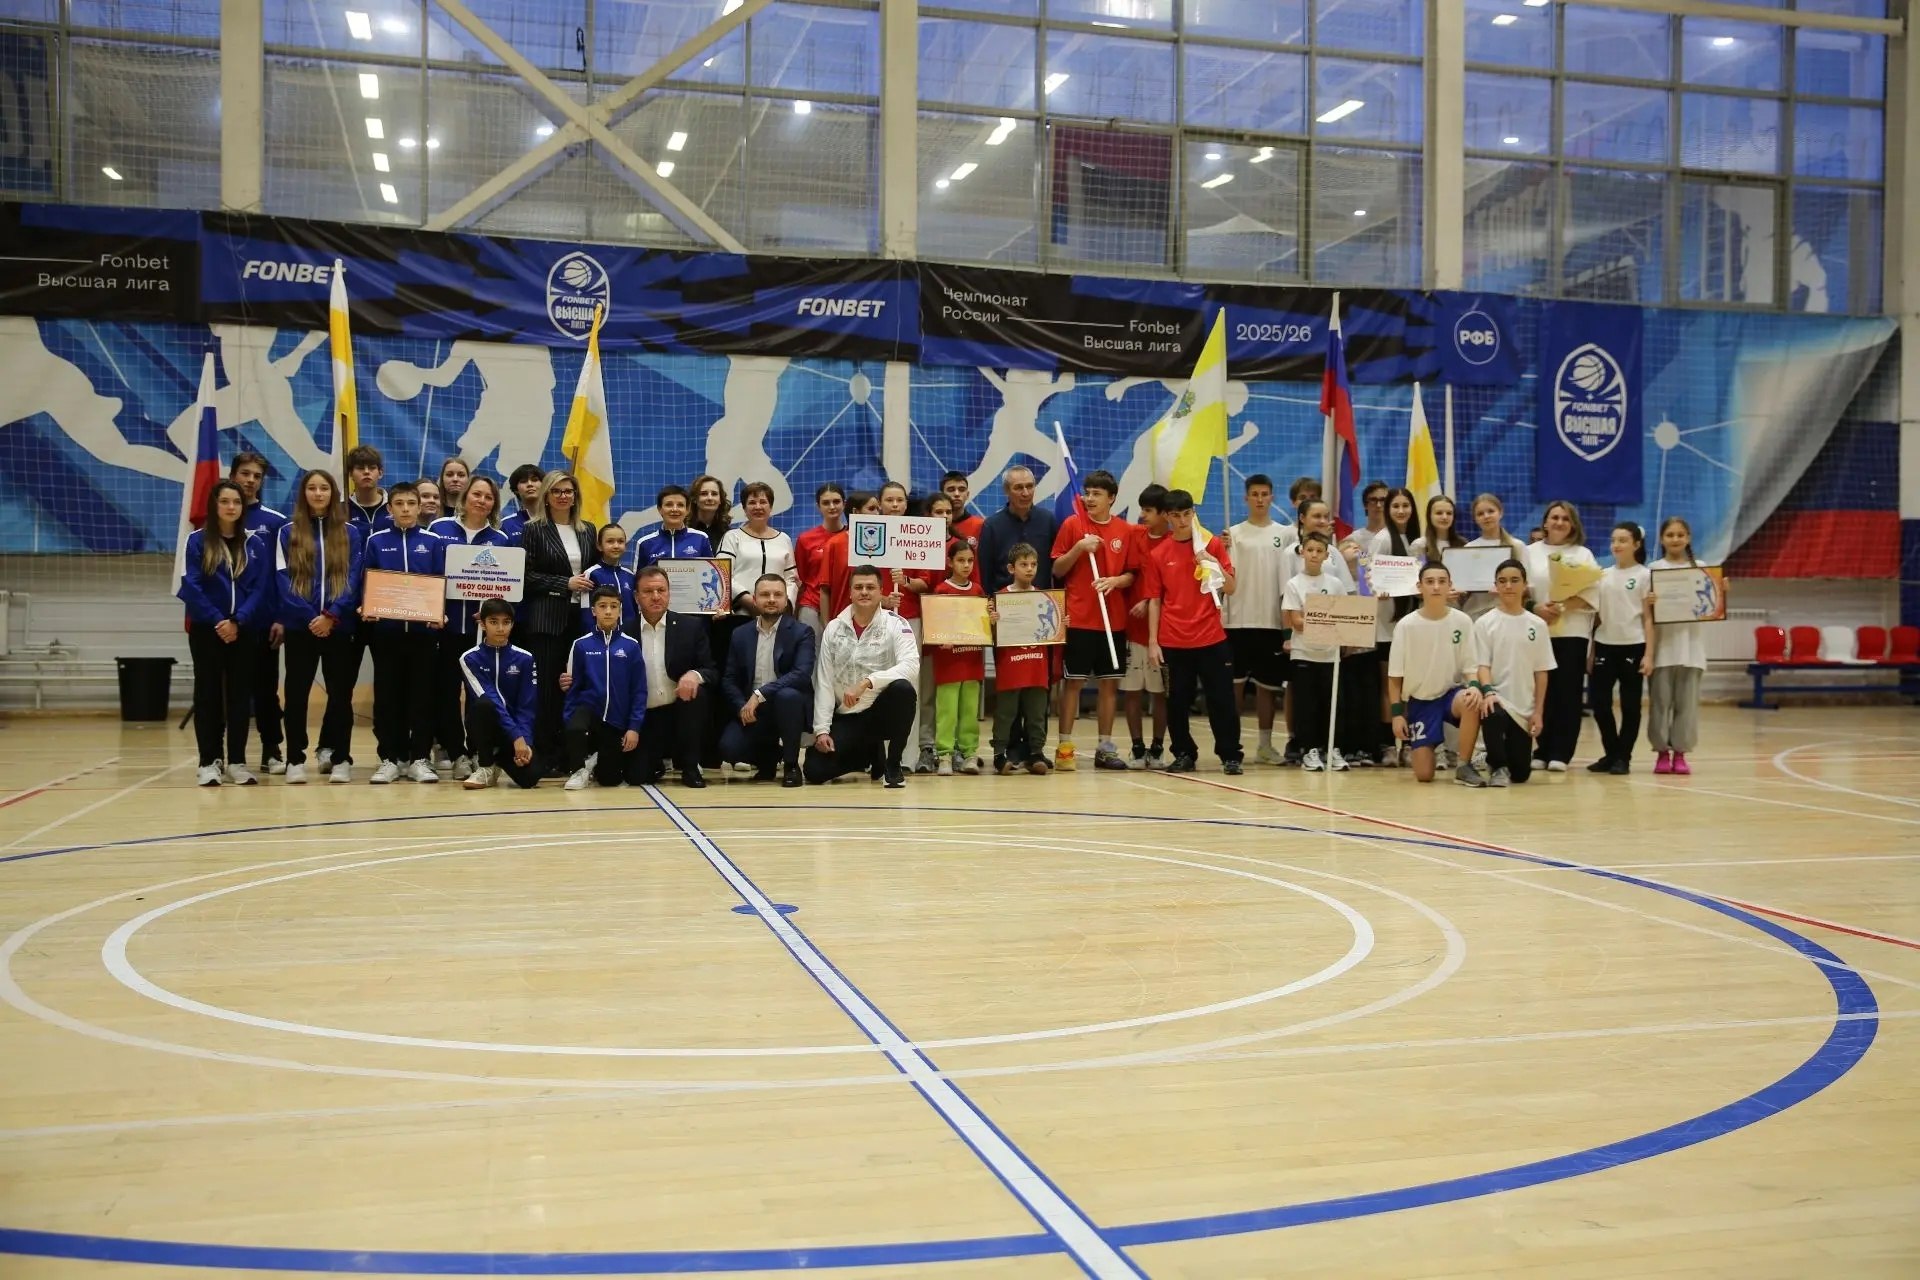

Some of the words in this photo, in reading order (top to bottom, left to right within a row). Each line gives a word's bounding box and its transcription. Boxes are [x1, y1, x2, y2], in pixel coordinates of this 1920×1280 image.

[100, 253, 170, 270] Fonbet
[38, 273, 117, 288] Высшая
[125, 278, 170, 291] лига
[561, 296, 597, 305] FONBET
[943, 287, 1028, 307] Чемпионат
[555, 305, 596, 320] ВЫСША
[797, 298, 885, 318] FONBET
[943, 306, 1000, 322] России
[1129, 320, 1181, 335] Fonbet
[1236, 323, 1312, 342] 2025/26
[1084, 335, 1143, 351] Высшая
[1148, 342, 1182, 352] лига
[1460, 330, 1495, 345] РФБ
[1565, 414, 1617, 435] ВЫСШАЯ
[900, 523, 932, 535] МБОУ
[890, 536, 942, 549] Гимназия
[1273, 536, 1281, 548] 3
[905, 550, 917, 560] №
[920, 551, 926, 560] 9
[456, 582, 476, 590] МБОУ
[1625, 578, 1636, 590] 3
[1452, 629, 1462, 644] 3
[1528, 628, 1536, 641] 3
